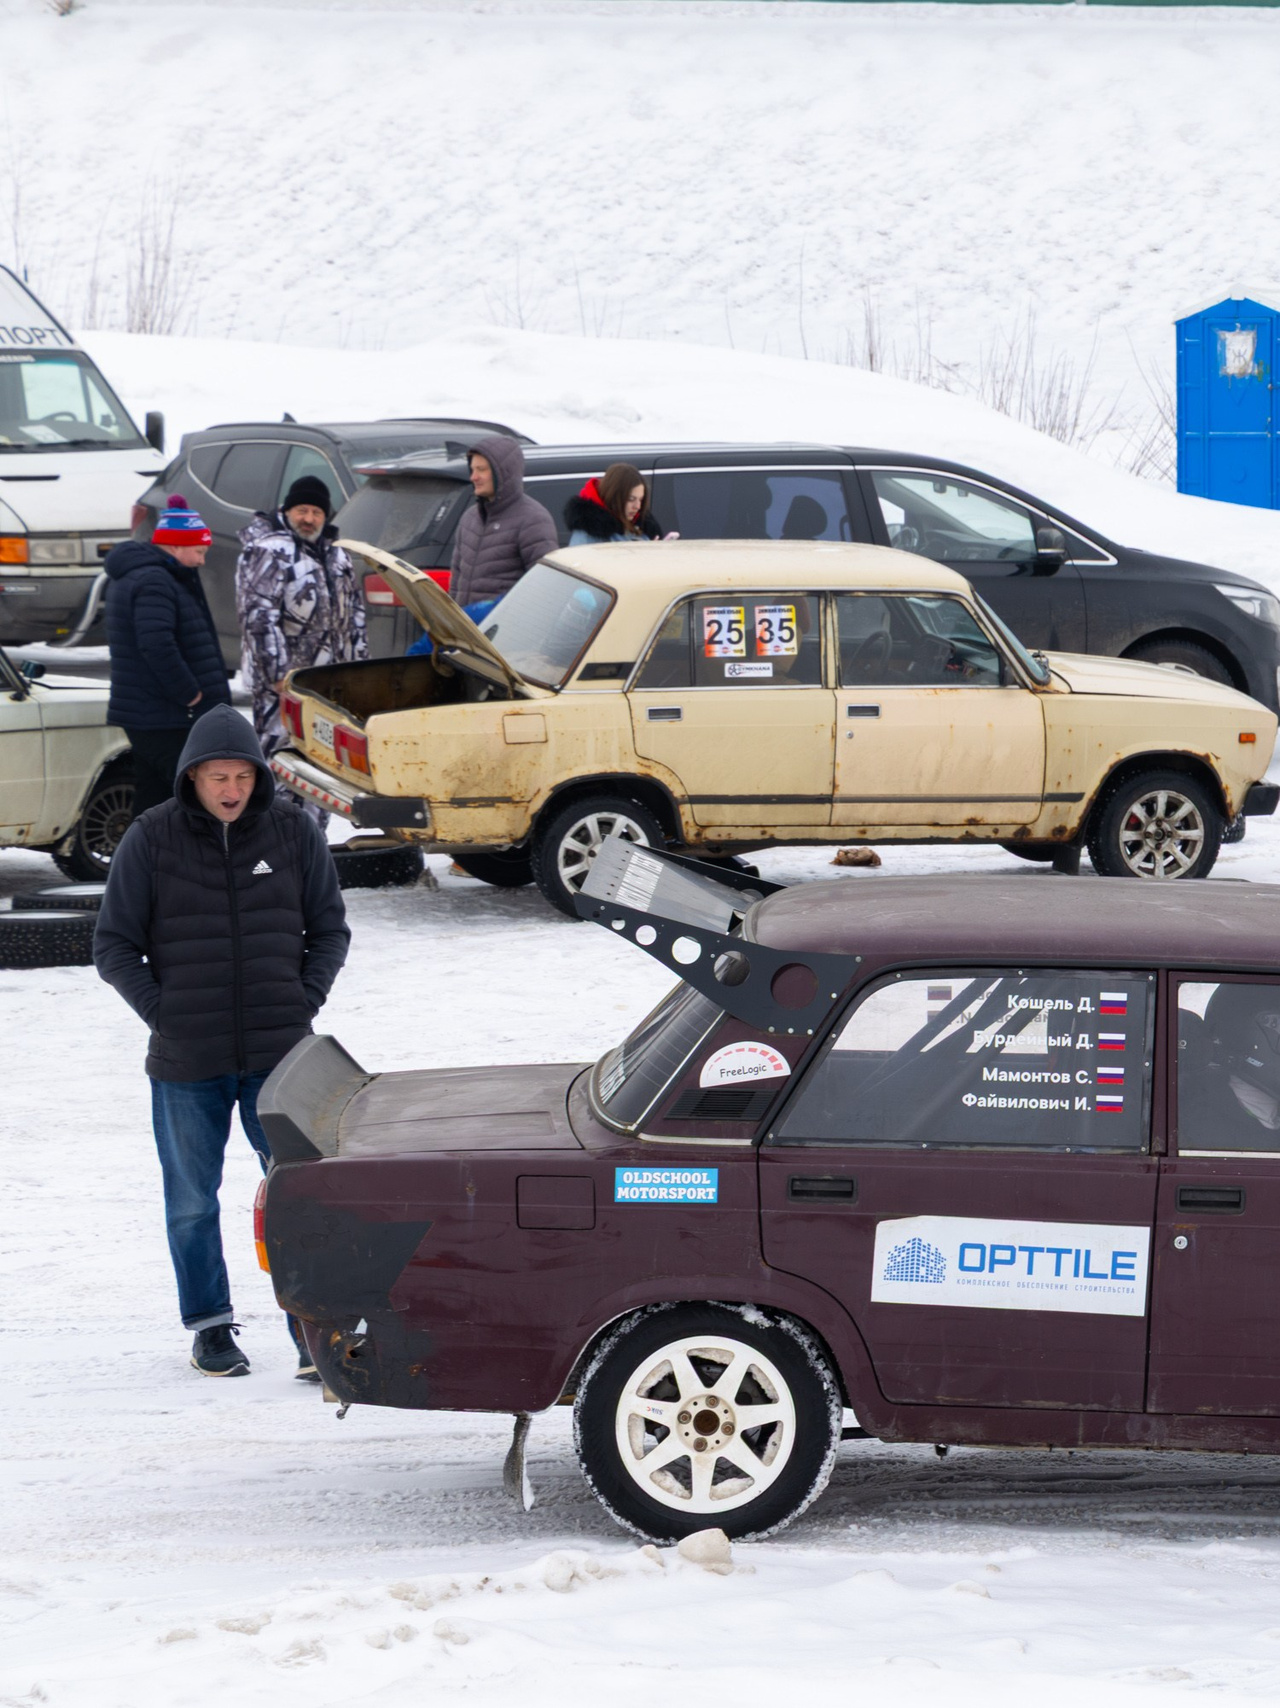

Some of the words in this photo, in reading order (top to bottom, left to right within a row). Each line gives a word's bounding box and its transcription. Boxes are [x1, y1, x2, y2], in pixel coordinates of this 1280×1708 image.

[706, 619, 744, 645] 25
[758, 617, 795, 644] 35
[1007, 994, 1074, 1011] Кошель
[1077, 997, 1096, 1013] Д.
[973, 1030, 1072, 1048] Бурдейный
[1075, 1033, 1094, 1050] Д.
[719, 1064, 767, 1078] FreeLogic
[982, 1067, 1070, 1083] Мамонтов
[1075, 1070, 1093, 1085] С.
[961, 1093, 1069, 1110] Файвилович
[1074, 1096, 1092, 1111] И.
[622, 1171, 711, 1185] OLDSCHOOL
[617, 1187, 716, 1200] MOTORSPORT
[958, 1242, 1138, 1281] OPTTILE
[956, 1278, 1010, 1288] КОМПЛЕКСНОЕ
[1016, 1281, 1069, 1291] ОБЕСПЕЧЕНИЕ
[1074, 1285, 1135, 1294] СТРОИТЕЛЬСТВА
